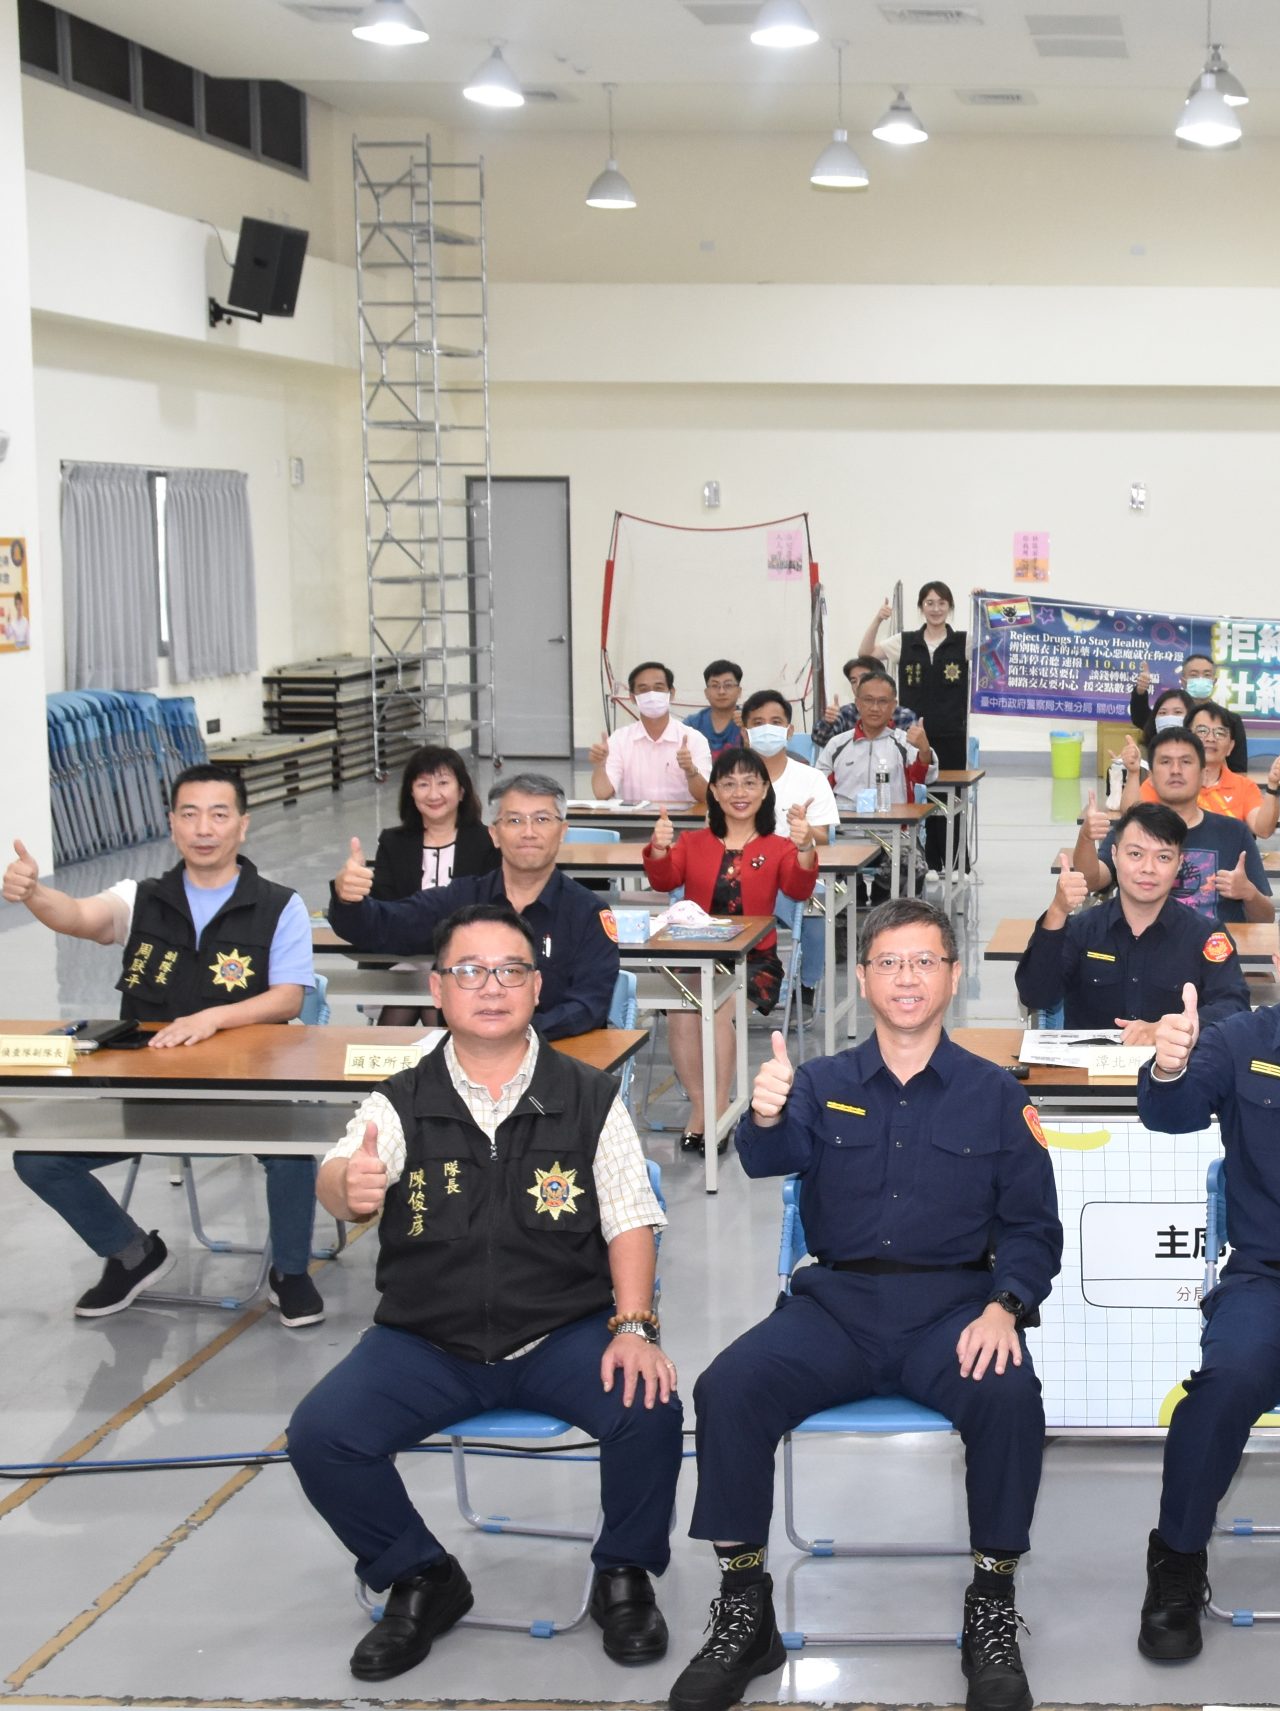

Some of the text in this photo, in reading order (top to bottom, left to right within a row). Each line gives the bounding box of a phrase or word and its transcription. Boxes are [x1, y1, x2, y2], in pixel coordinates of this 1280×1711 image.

[1010, 630, 1151, 651] Reject Drugs To Stay Healthy
[1008, 676, 1079, 691] 網路交友要小心
[1089, 670, 1160, 684] 談錢轉帳必騙
[352, 1055, 413, 1069] 頭家所長
[443, 1160, 463, 1195] 隊長
